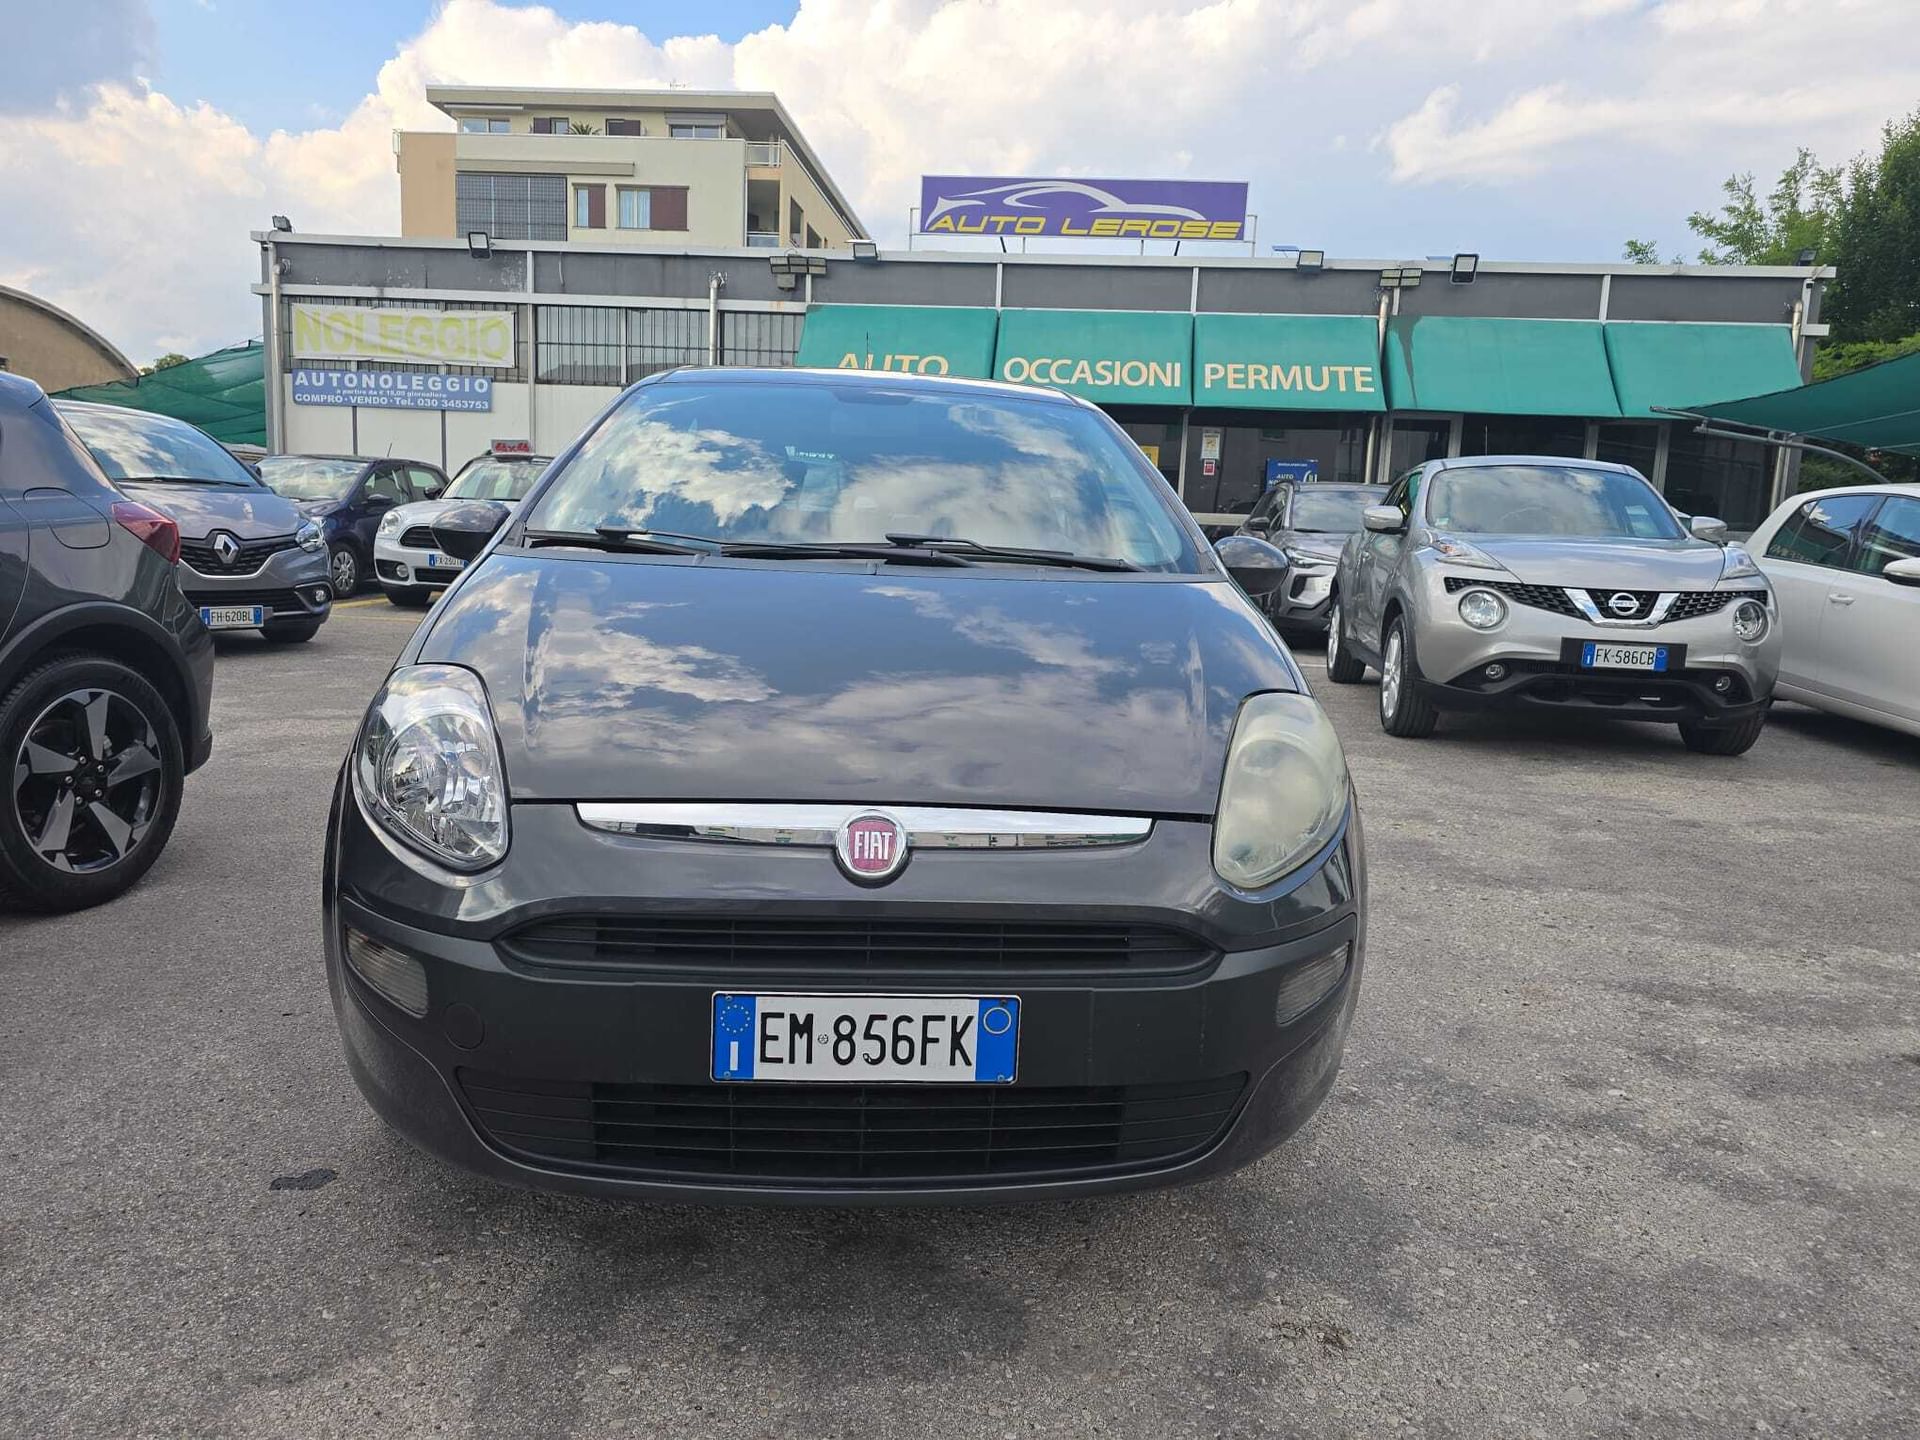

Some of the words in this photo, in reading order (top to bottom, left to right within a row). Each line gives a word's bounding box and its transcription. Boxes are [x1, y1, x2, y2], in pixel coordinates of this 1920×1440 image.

[929, 215, 1046, 233] AUTO
[1061, 217, 1242, 239] LEROSE
[295, 308, 510, 360] NOLEGGIO
[295, 371, 488, 393] AUTONOLEGGIO
[838, 353, 949, 374] AUTO
[1003, 356, 1181, 387] OCCASIONI
[1204, 363, 1375, 393] PERMUTE
[295, 394, 343, 403] COMPRO
[349, 396, 388, 405] VENDO
[417, 398, 438, 407] 030
[854, 831, 892, 860] FIAT
